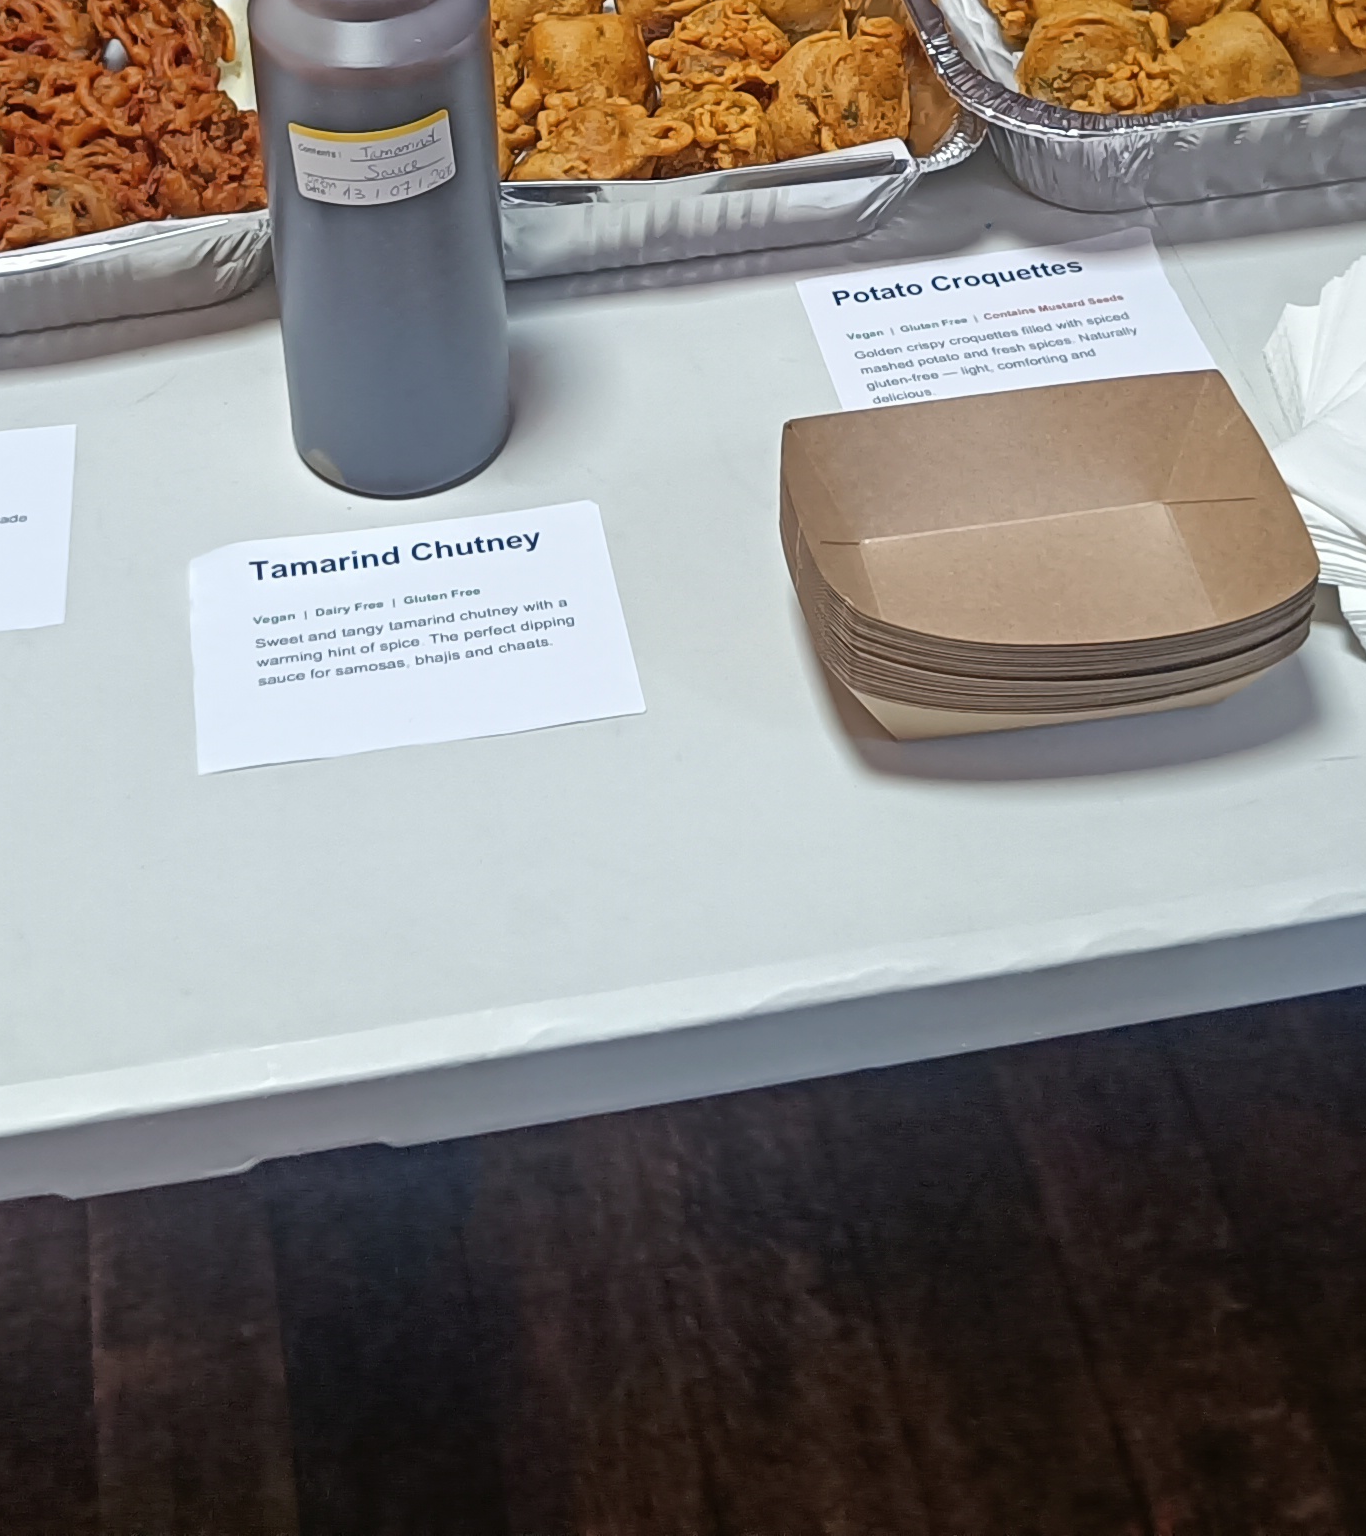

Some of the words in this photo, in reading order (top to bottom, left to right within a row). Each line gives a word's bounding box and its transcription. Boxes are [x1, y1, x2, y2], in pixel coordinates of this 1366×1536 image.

[364, 160, 421, 180] Sauce
[832, 282, 923, 306] Potato
[931, 261, 1083, 292] Croquettes
[846, 329, 884, 340] Vegan
[900, 320, 939, 333] Gluten
[941, 317, 968, 327] Free
[983, 307, 1036, 321] Contains
[1038, 299, 1086, 313] Mustard
[1088, 294, 1124, 306] Seeds
[854, 345, 903, 360] Golden
[906, 338, 946, 354] crispy
[949, 329, 1019, 347] croquettes
[1021, 322, 1052, 336] filled
[1056, 317, 1083, 330] with
[1086, 311, 1130, 327] spiced
[860, 359, 915, 375] mashed
[917, 351, 960, 368] potato
[963, 347, 988, 359] and
[991, 343, 1026, 356] fresh
[1078, 326, 1138, 344] Naturally
[866, 370, 939, 392] gluten-free
[997, 352, 1068, 372] comforting
[1071, 348, 1096, 360] and
[249, 546, 400, 580] Tamarind
[411, 532, 540, 561] Chutney
[253, 613, 296, 625] Vegan
[315, 605, 351, 617] Dairy
[355, 601, 384, 611] Free
[403, 591, 448, 605] Gluten
[451, 588, 481, 598] Free
[255, 634, 304, 649] Sweet
[308, 629, 337, 642] and
[342, 624, 384, 638] tangy
[389, 612, 455, 631] tamarind
[459, 605, 519, 620] chutney
[523, 599, 553, 612] with
[558, 599, 568, 608] a
[256, 650, 323, 667] warming
[328, 645, 356, 658] hint
[360, 642, 375, 654] of
[429, 632, 459, 645] The
[464, 624, 516, 642] perfect
[520, 616, 575, 632] dipping
[258, 672, 305, 686] sauce
[310, 667, 331, 679] for
[415, 650, 461, 666] bhajis
[465, 644, 494, 659] and
[498, 638, 553, 654] chaats.
